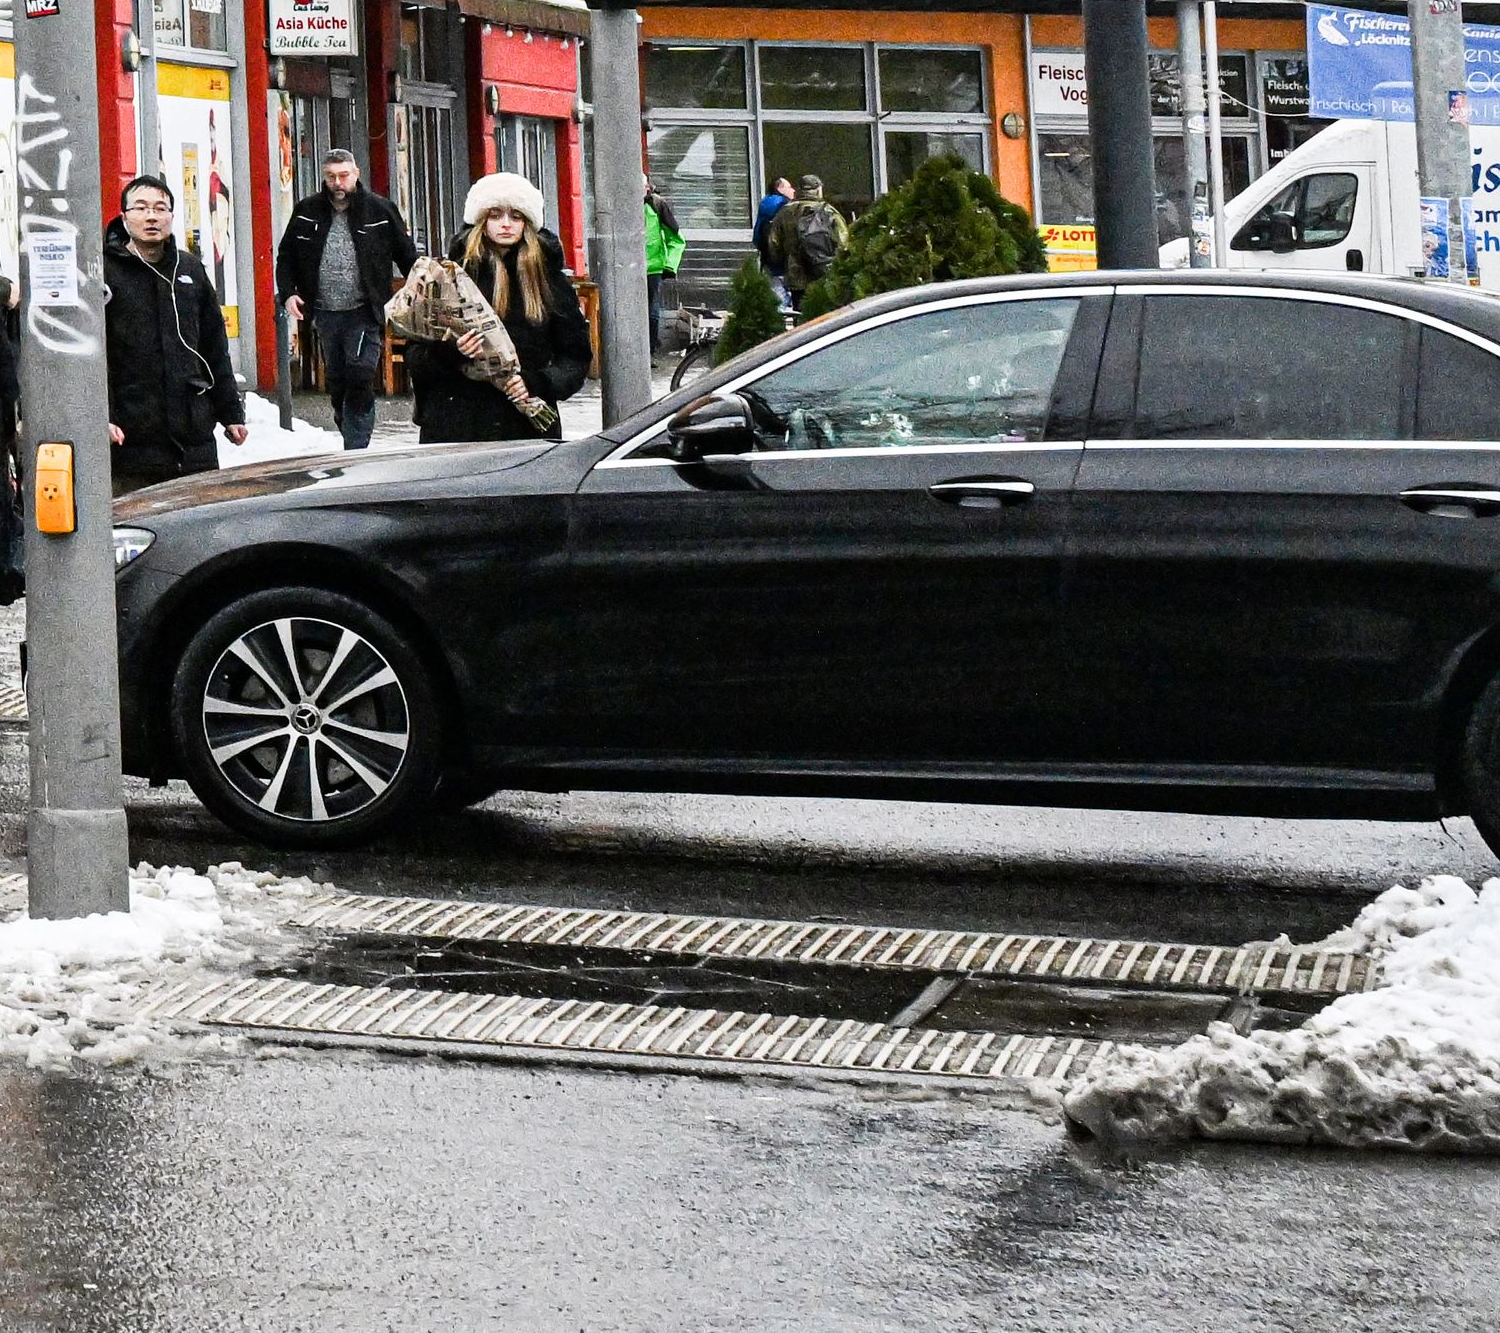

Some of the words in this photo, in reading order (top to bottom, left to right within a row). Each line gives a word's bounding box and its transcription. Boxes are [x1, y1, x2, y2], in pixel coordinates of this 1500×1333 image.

[276, 17, 303, 30] Asia
[307, 16, 348, 30] Küche
[275, 35, 320, 49] Bubble
[323, 35, 347, 48] Tea
[1038, 65, 1087, 81] Fleisc
[1267, 80, 1303, 91] Fleisch-
